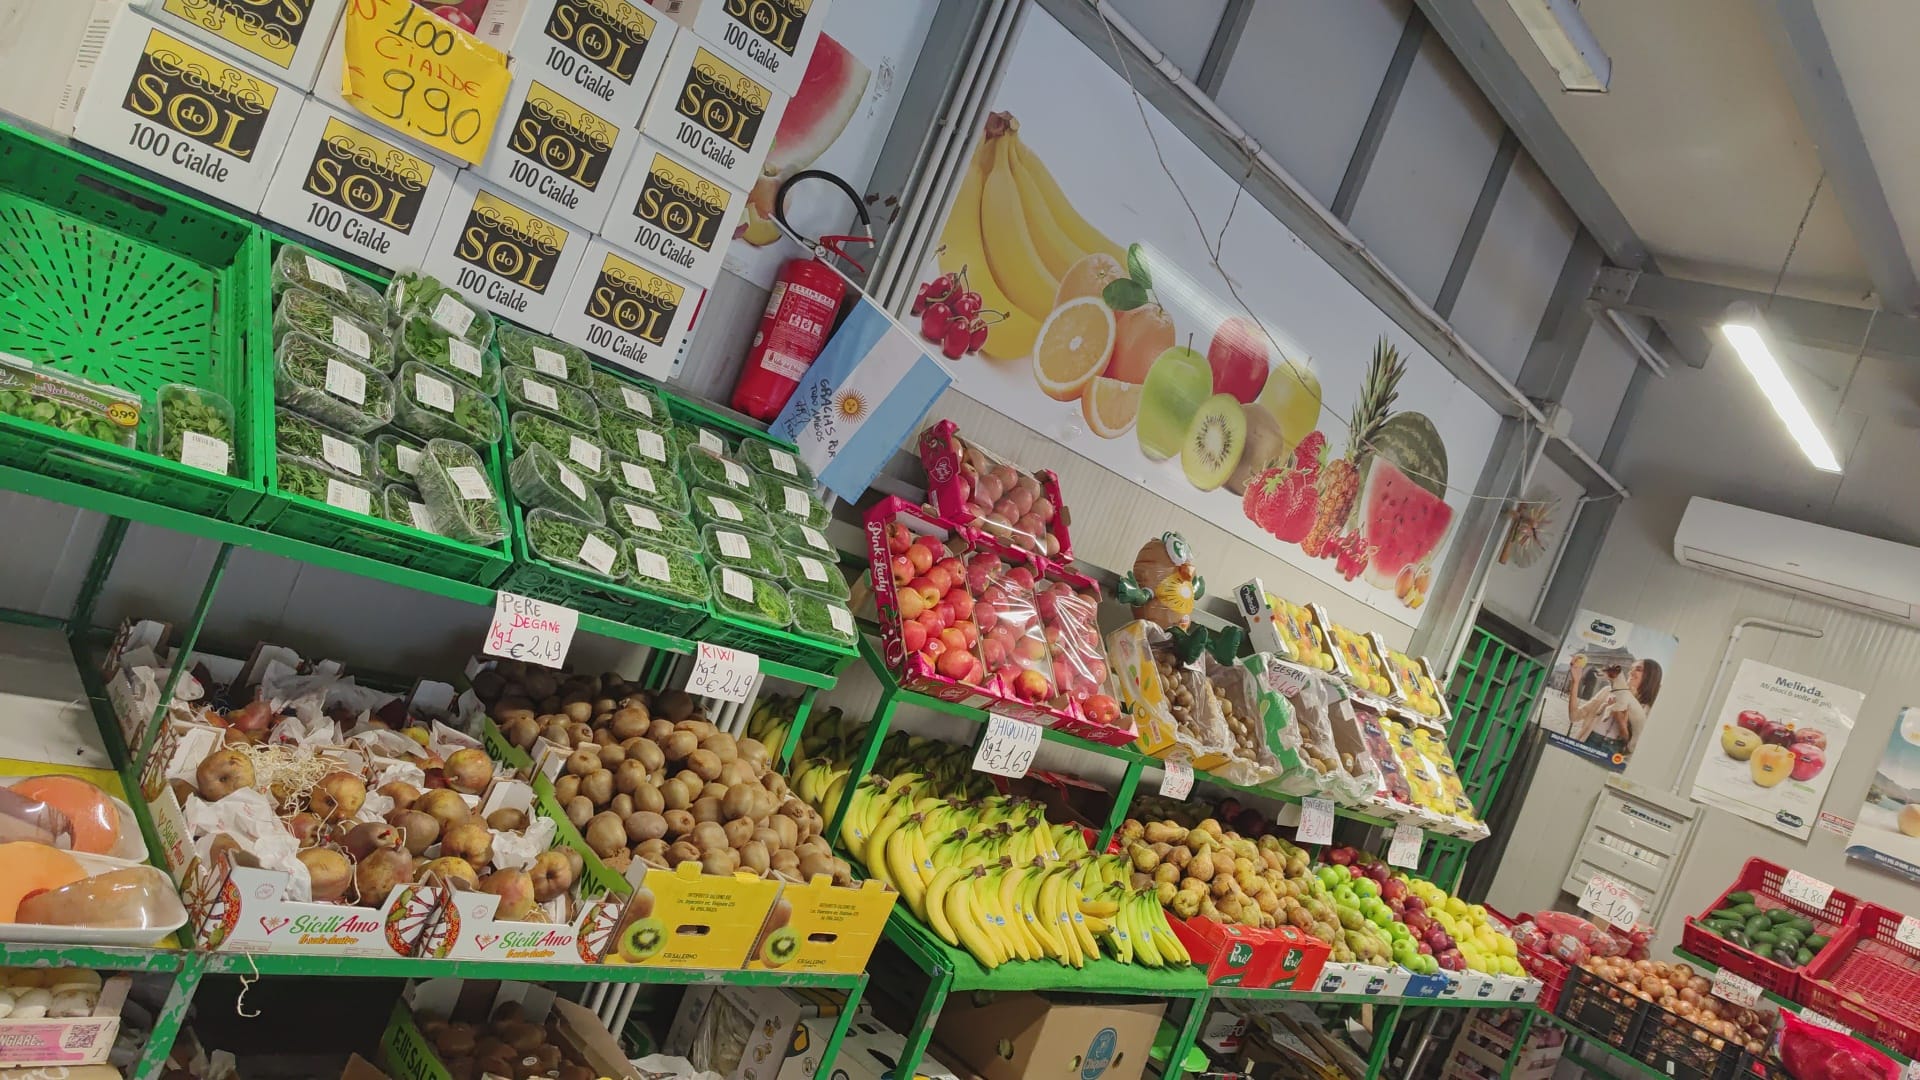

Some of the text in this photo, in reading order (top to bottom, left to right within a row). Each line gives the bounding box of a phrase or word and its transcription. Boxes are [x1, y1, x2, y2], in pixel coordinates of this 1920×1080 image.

[385, 3, 455, 56] 100
[756, 10, 769, 24] do
[550, 4, 632, 80] SOL
[586, 34, 602, 50] do
[724, 22, 780, 73] 100 Cialde
[150, 49, 264, 115] cafè
[546, 46, 615, 102] 100 Cialde
[695, 63, 765, 116] cafè
[130, 73, 251, 157] SOL
[181, 105, 205, 125] do
[529, 97, 608, 153] cafè
[680, 83, 750, 150] SOL
[711, 109, 725, 124] do
[129, 122, 229, 183] 100 Cialde
[328, 135, 423, 192] cafè
[513, 118, 596, 188] SOL
[550, 145, 565, 162] do
[676, 121, 736, 170] 100 Cialde
[309, 158, 411, 231] SOL
[352, 186, 372, 203] do
[509, 159, 579, 210] 100 Cialde
[653, 168, 724, 216] cafè
[306, 202, 391, 255] 100 Cialde
[477, 206, 559, 256] cafè
[639, 187, 711, 248] SOL
[670, 210, 684, 225] do
[460, 226, 546, 291] SOL
[496, 251, 513, 267] do
[634, 225, 695, 270] 100 Cialde
[456, 266, 528, 313] 100 Cialde
[603, 266, 676, 311] cafè
[589, 286, 664, 344] SOL
[621, 308, 636, 322] do
[586, 323, 648, 365] 100 Cialde
[867, 521, 890, 592] Pink Lady
[502, 594, 542, 617] PERE
[510, 613, 560, 634] DEGANE
[701, 643, 735, 662] KIWI
[1273, 664, 1306, 682] ZESPRI
[988, 717, 1037, 744] CHIQUITA
[289, 914, 379, 934] SiciliAmo
[499, 930, 572, 949] SiciliAmo
